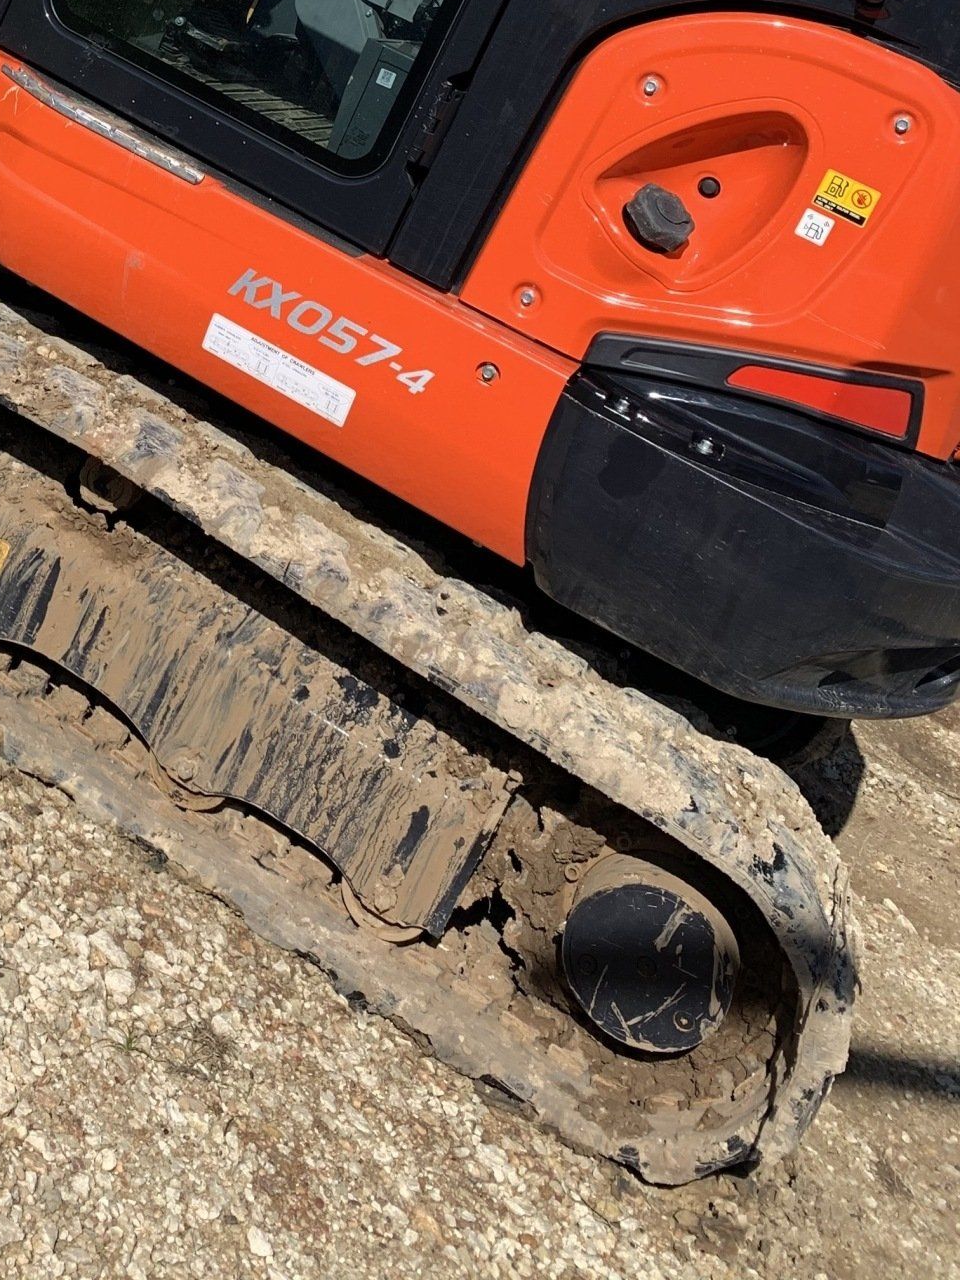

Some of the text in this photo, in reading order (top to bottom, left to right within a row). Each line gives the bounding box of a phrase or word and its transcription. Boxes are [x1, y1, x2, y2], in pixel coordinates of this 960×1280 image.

[226, 267, 436, 395] KX057-4
[251, 336, 280, 356] ADJUSTMENT
[289, 358, 315, 376] CRAWLERS
